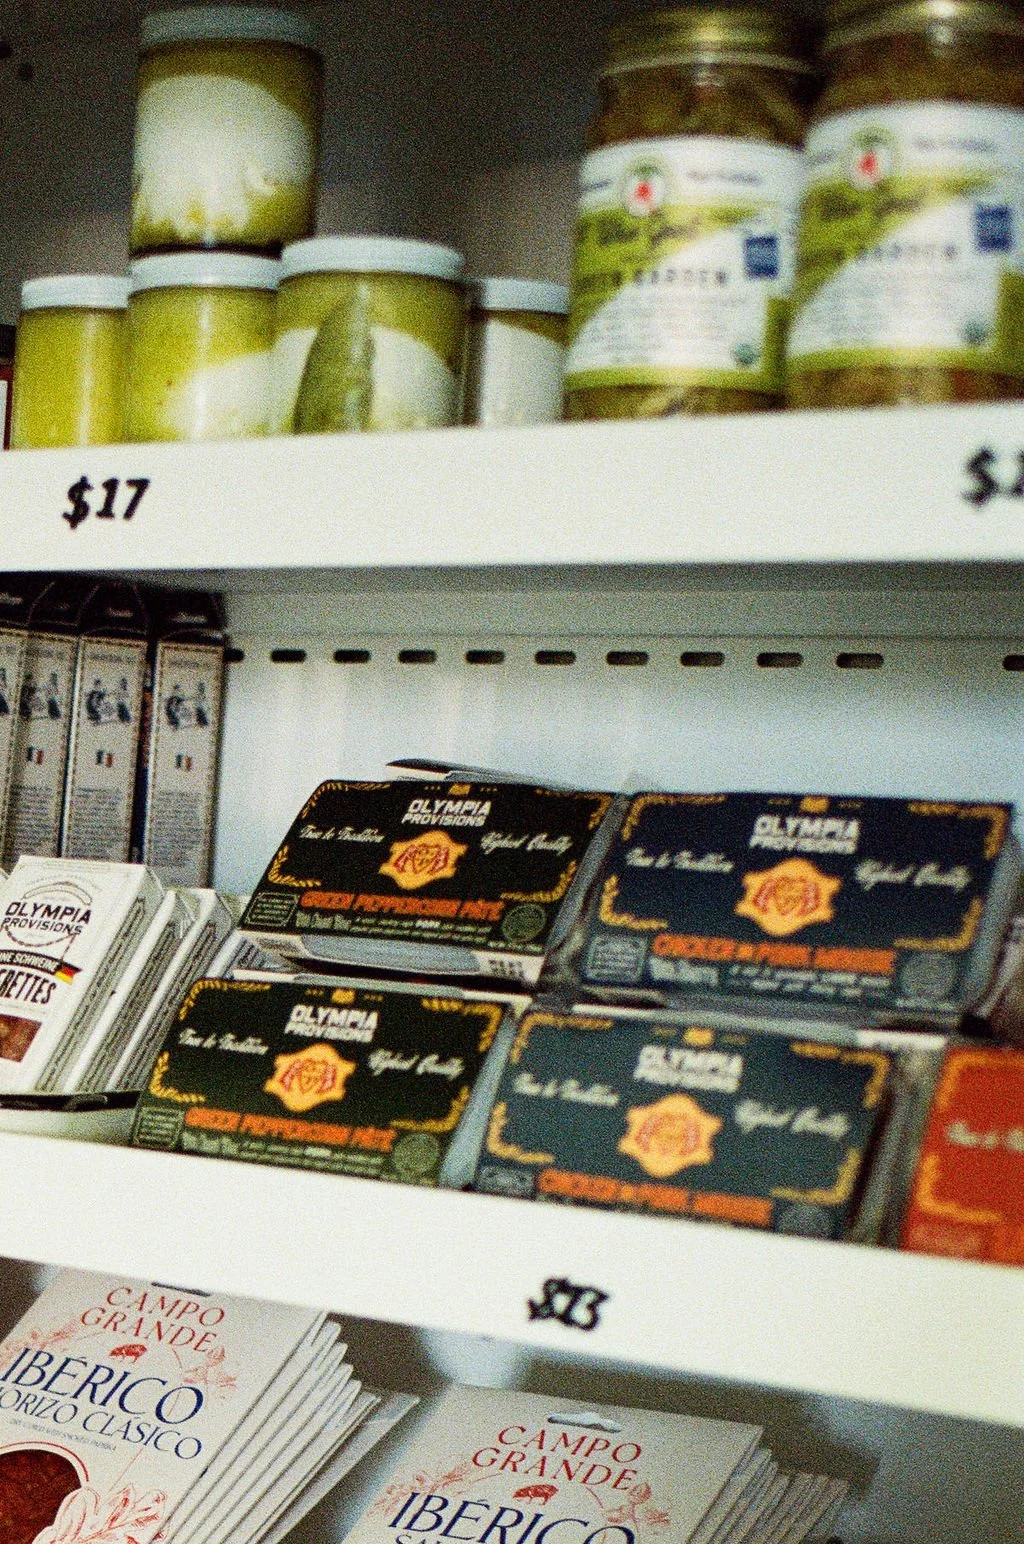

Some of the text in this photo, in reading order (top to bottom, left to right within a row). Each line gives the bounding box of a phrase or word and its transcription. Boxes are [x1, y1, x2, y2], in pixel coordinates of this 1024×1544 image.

[62, 475, 150, 529] $17
[401, 812, 488, 828] PROVISIONS
[407, 798, 491, 817] OLYMPIA
[753, 814, 860, 839] OLYMPIA
[748, 834, 858, 856] PROVISIONS
[5, 901, 92, 925] OLYMPIA
[3, 917, 84, 936] PROVISIONS
[290, 1004, 379, 1029] OLYMPIA
[284, 1023, 373, 1043] PROVISIONS
[639, 1044, 743, 1074] OLYMPIA
[104, 1286, 227, 1328] CAMPO
[79, 1306, 219, 1355] GRANDE
[497, 1425, 643, 1464] CAMPO
[470, 1446, 640, 1492] GRANDE
